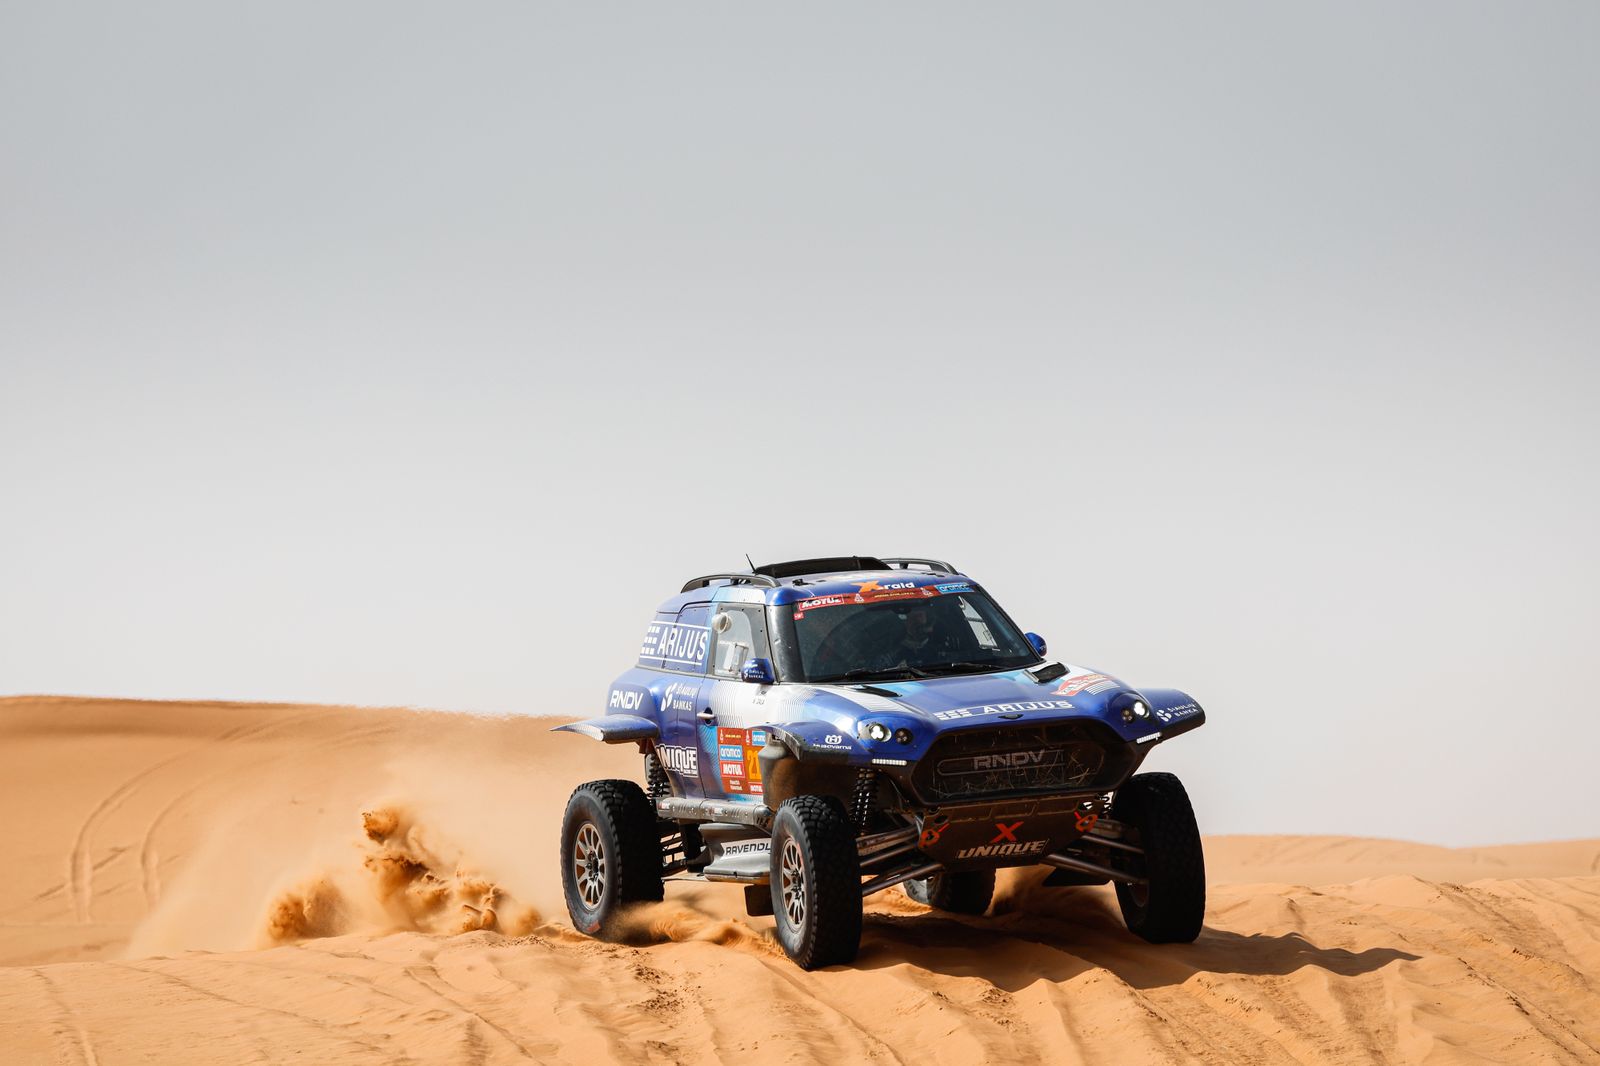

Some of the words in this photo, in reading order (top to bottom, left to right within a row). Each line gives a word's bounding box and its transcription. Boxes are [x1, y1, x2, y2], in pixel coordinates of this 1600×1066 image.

[801, 598, 842, 609] MOTUL
[657, 627, 708, 660] ARIJUS
[609, 690, 643, 710] RNDV
[672, 699, 693, 711] BANKAS
[982, 700, 1073, 715] ARIJUS
[720, 747, 741, 759] aramco
[973, 750, 1045, 770] RNDV
[722, 763, 743, 776] MOTUL
[958, 840, 1046, 858] UNIQUE
